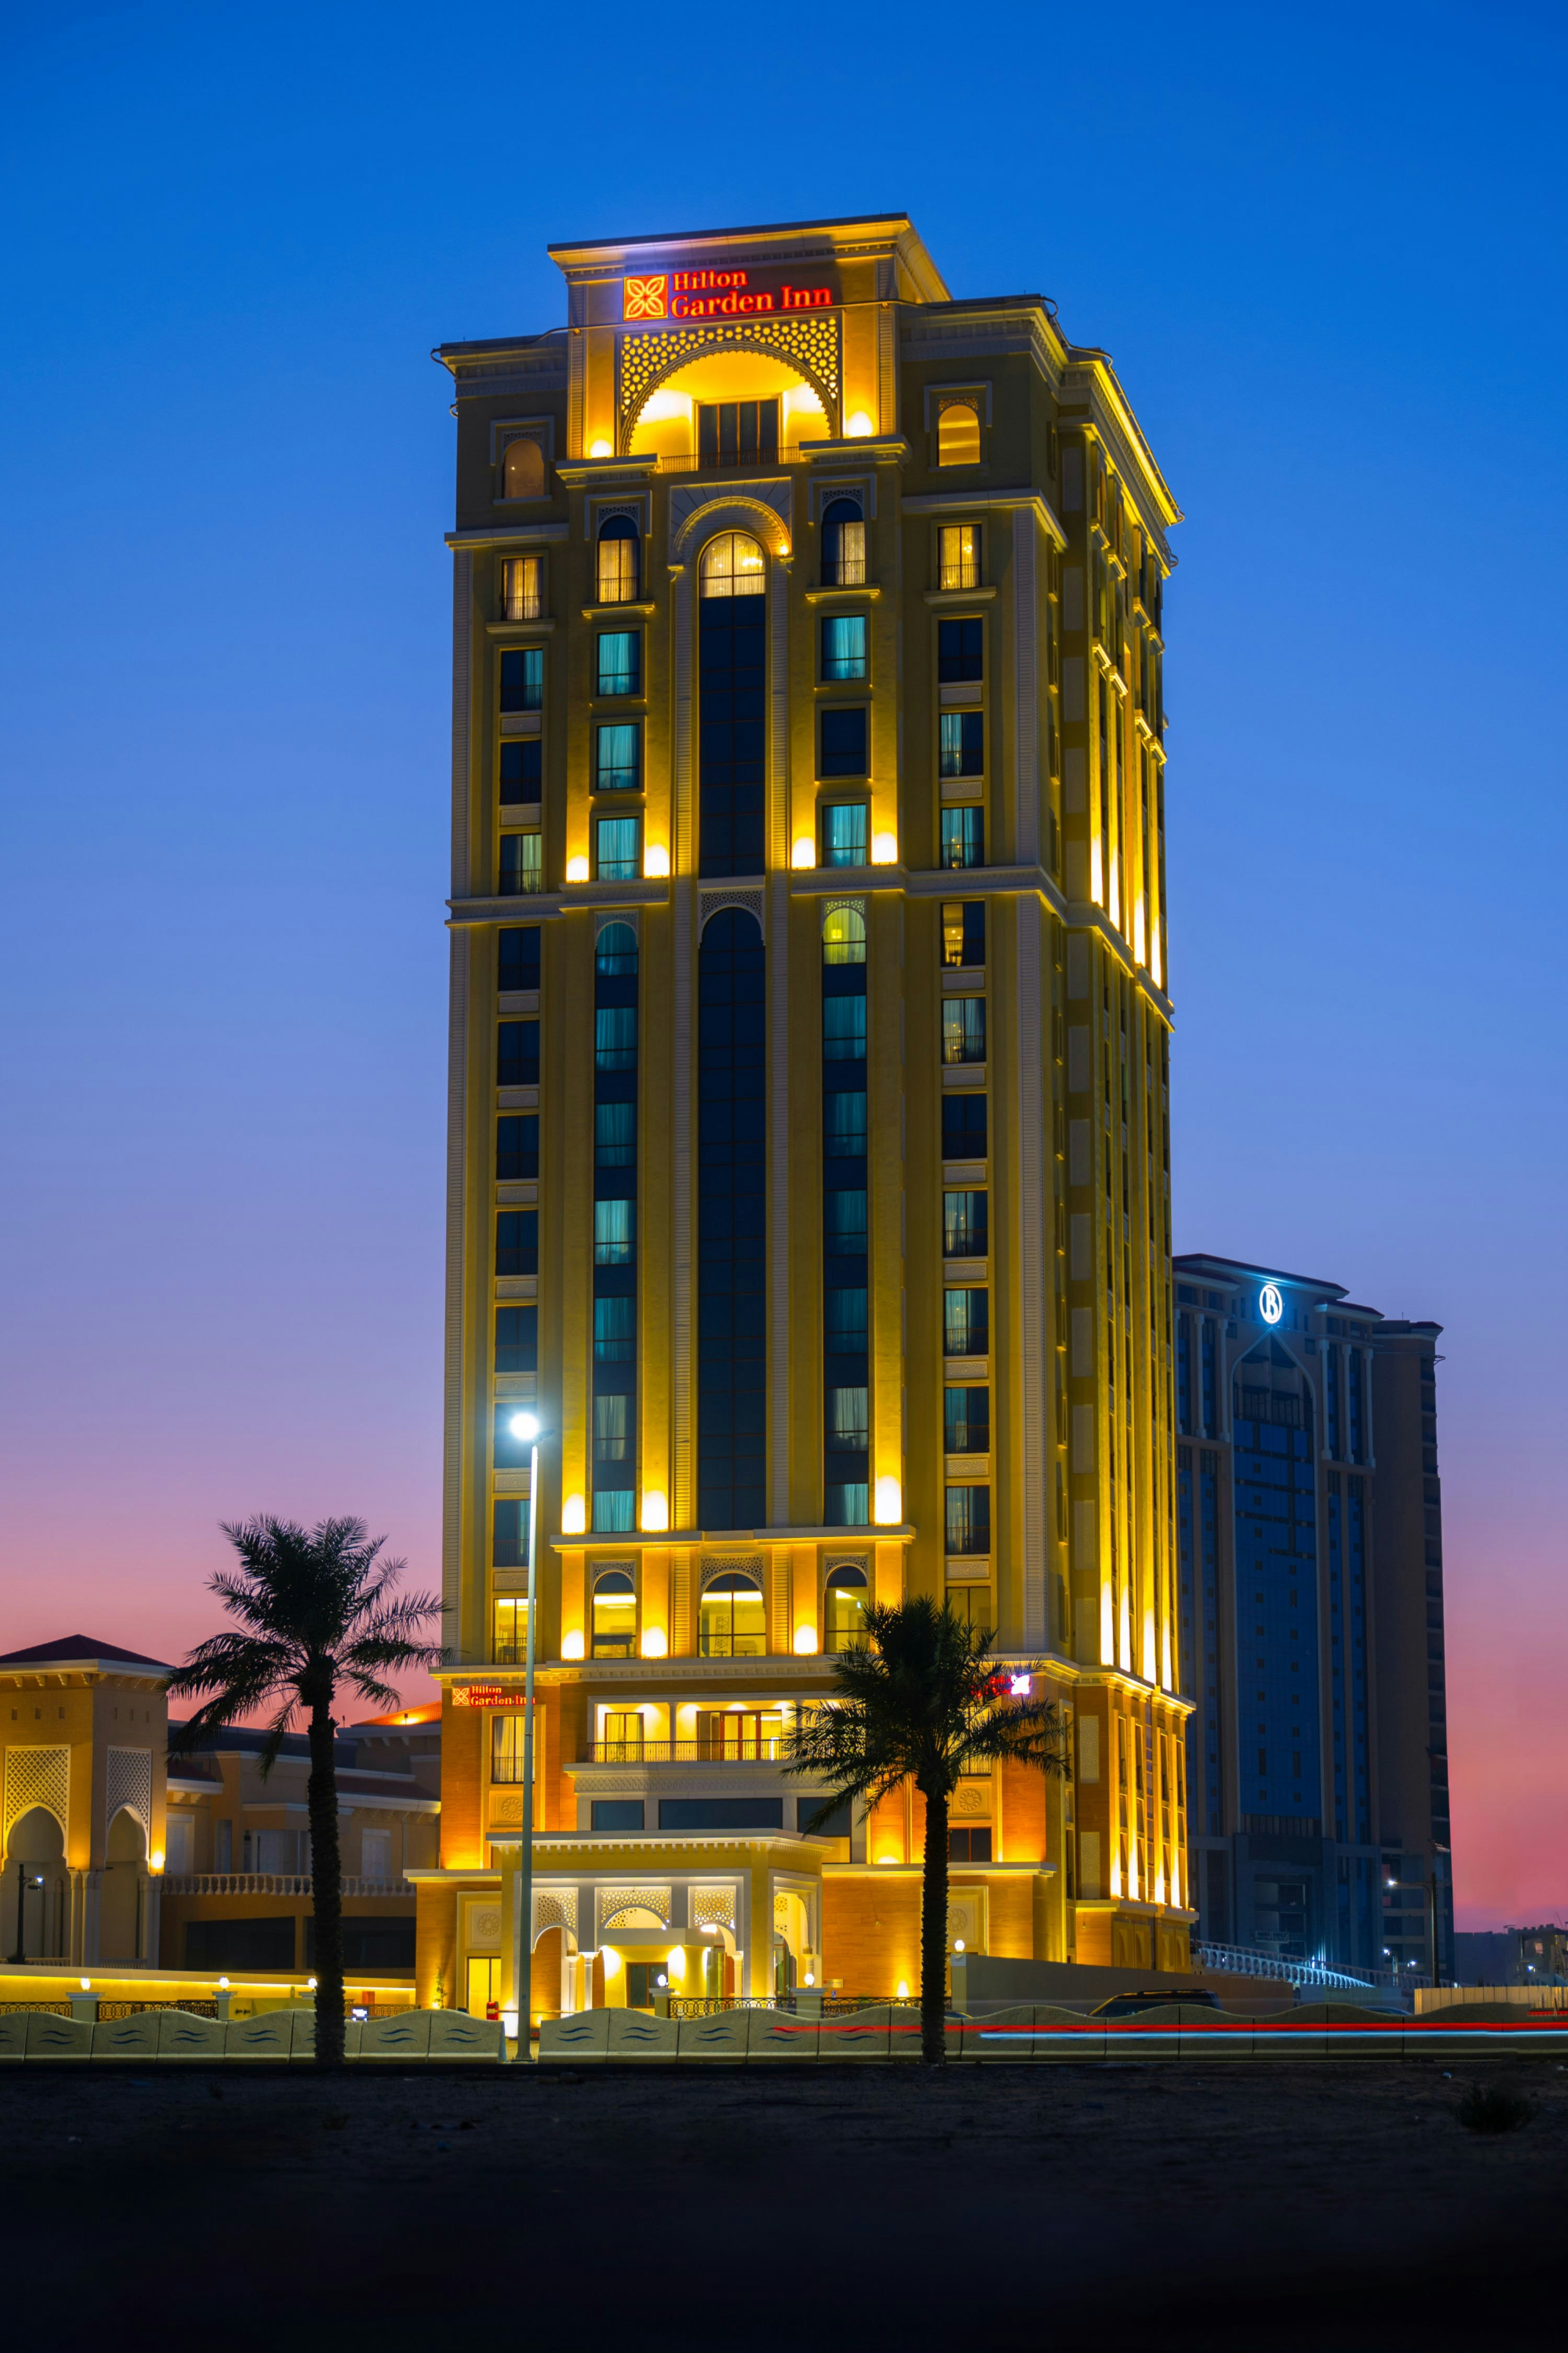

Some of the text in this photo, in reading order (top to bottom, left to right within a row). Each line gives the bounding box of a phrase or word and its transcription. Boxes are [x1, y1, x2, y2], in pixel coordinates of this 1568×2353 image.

[673, 270, 747, 291] Hilton
[671, 286, 832, 318] Garden Inn
[471, 1695, 513, 1706] Garden
